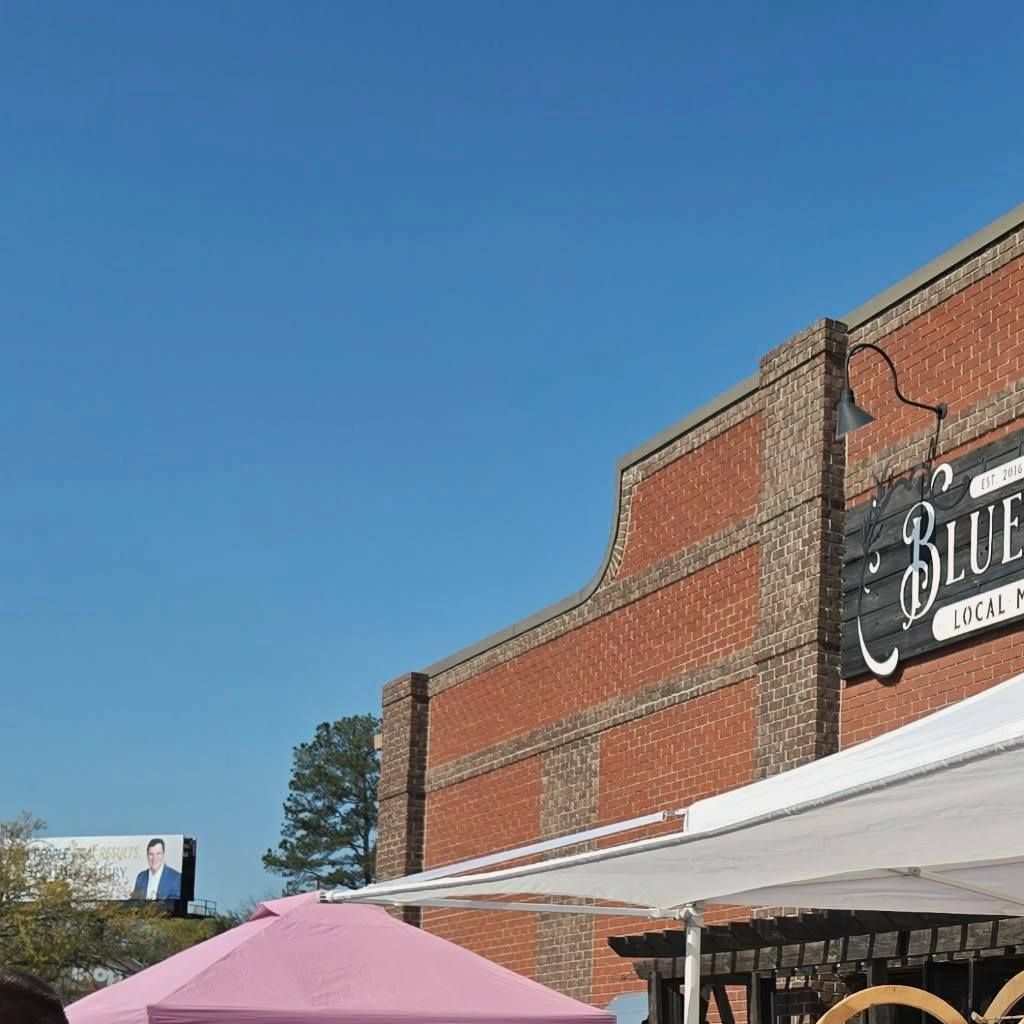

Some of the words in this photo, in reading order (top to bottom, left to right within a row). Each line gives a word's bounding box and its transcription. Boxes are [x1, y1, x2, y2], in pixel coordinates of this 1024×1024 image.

[981, 473, 999, 490] EST.
[1003, 463, 1023, 481] 2016
[953, 593, 1006, 631] LOCAL
